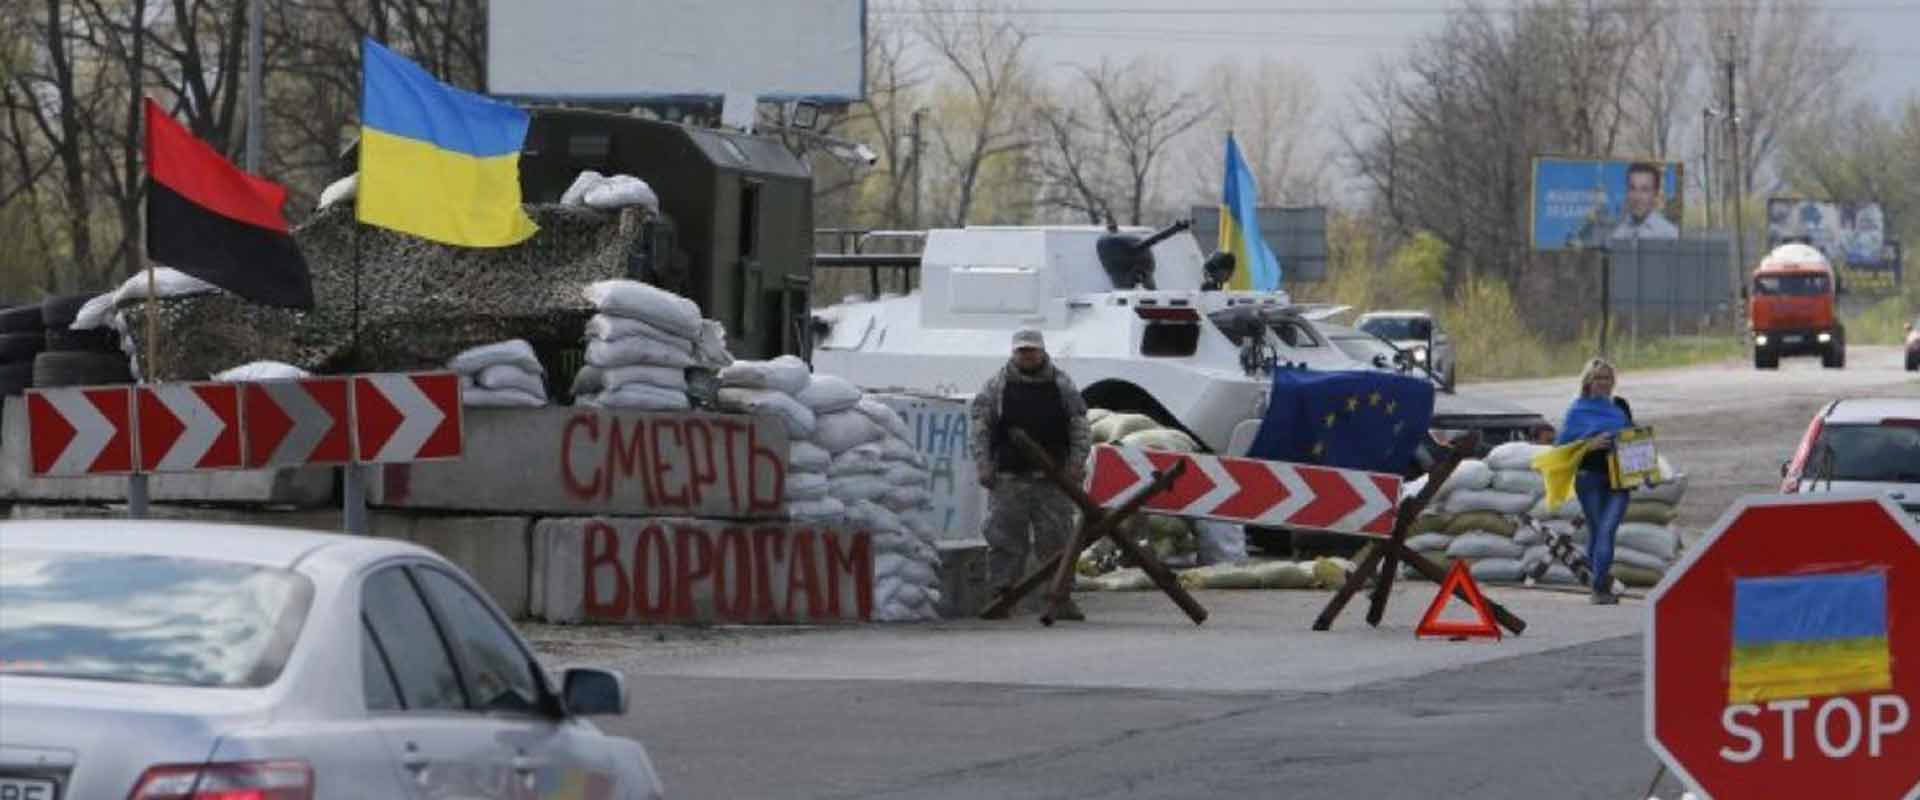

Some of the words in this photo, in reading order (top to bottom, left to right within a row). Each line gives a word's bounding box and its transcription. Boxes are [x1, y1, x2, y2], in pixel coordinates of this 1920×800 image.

[561, 408, 787, 513] СМЕРТЬ
[583, 520, 877, 622] ВОРОГАМ
[1719, 694, 1910, 763] STOP
